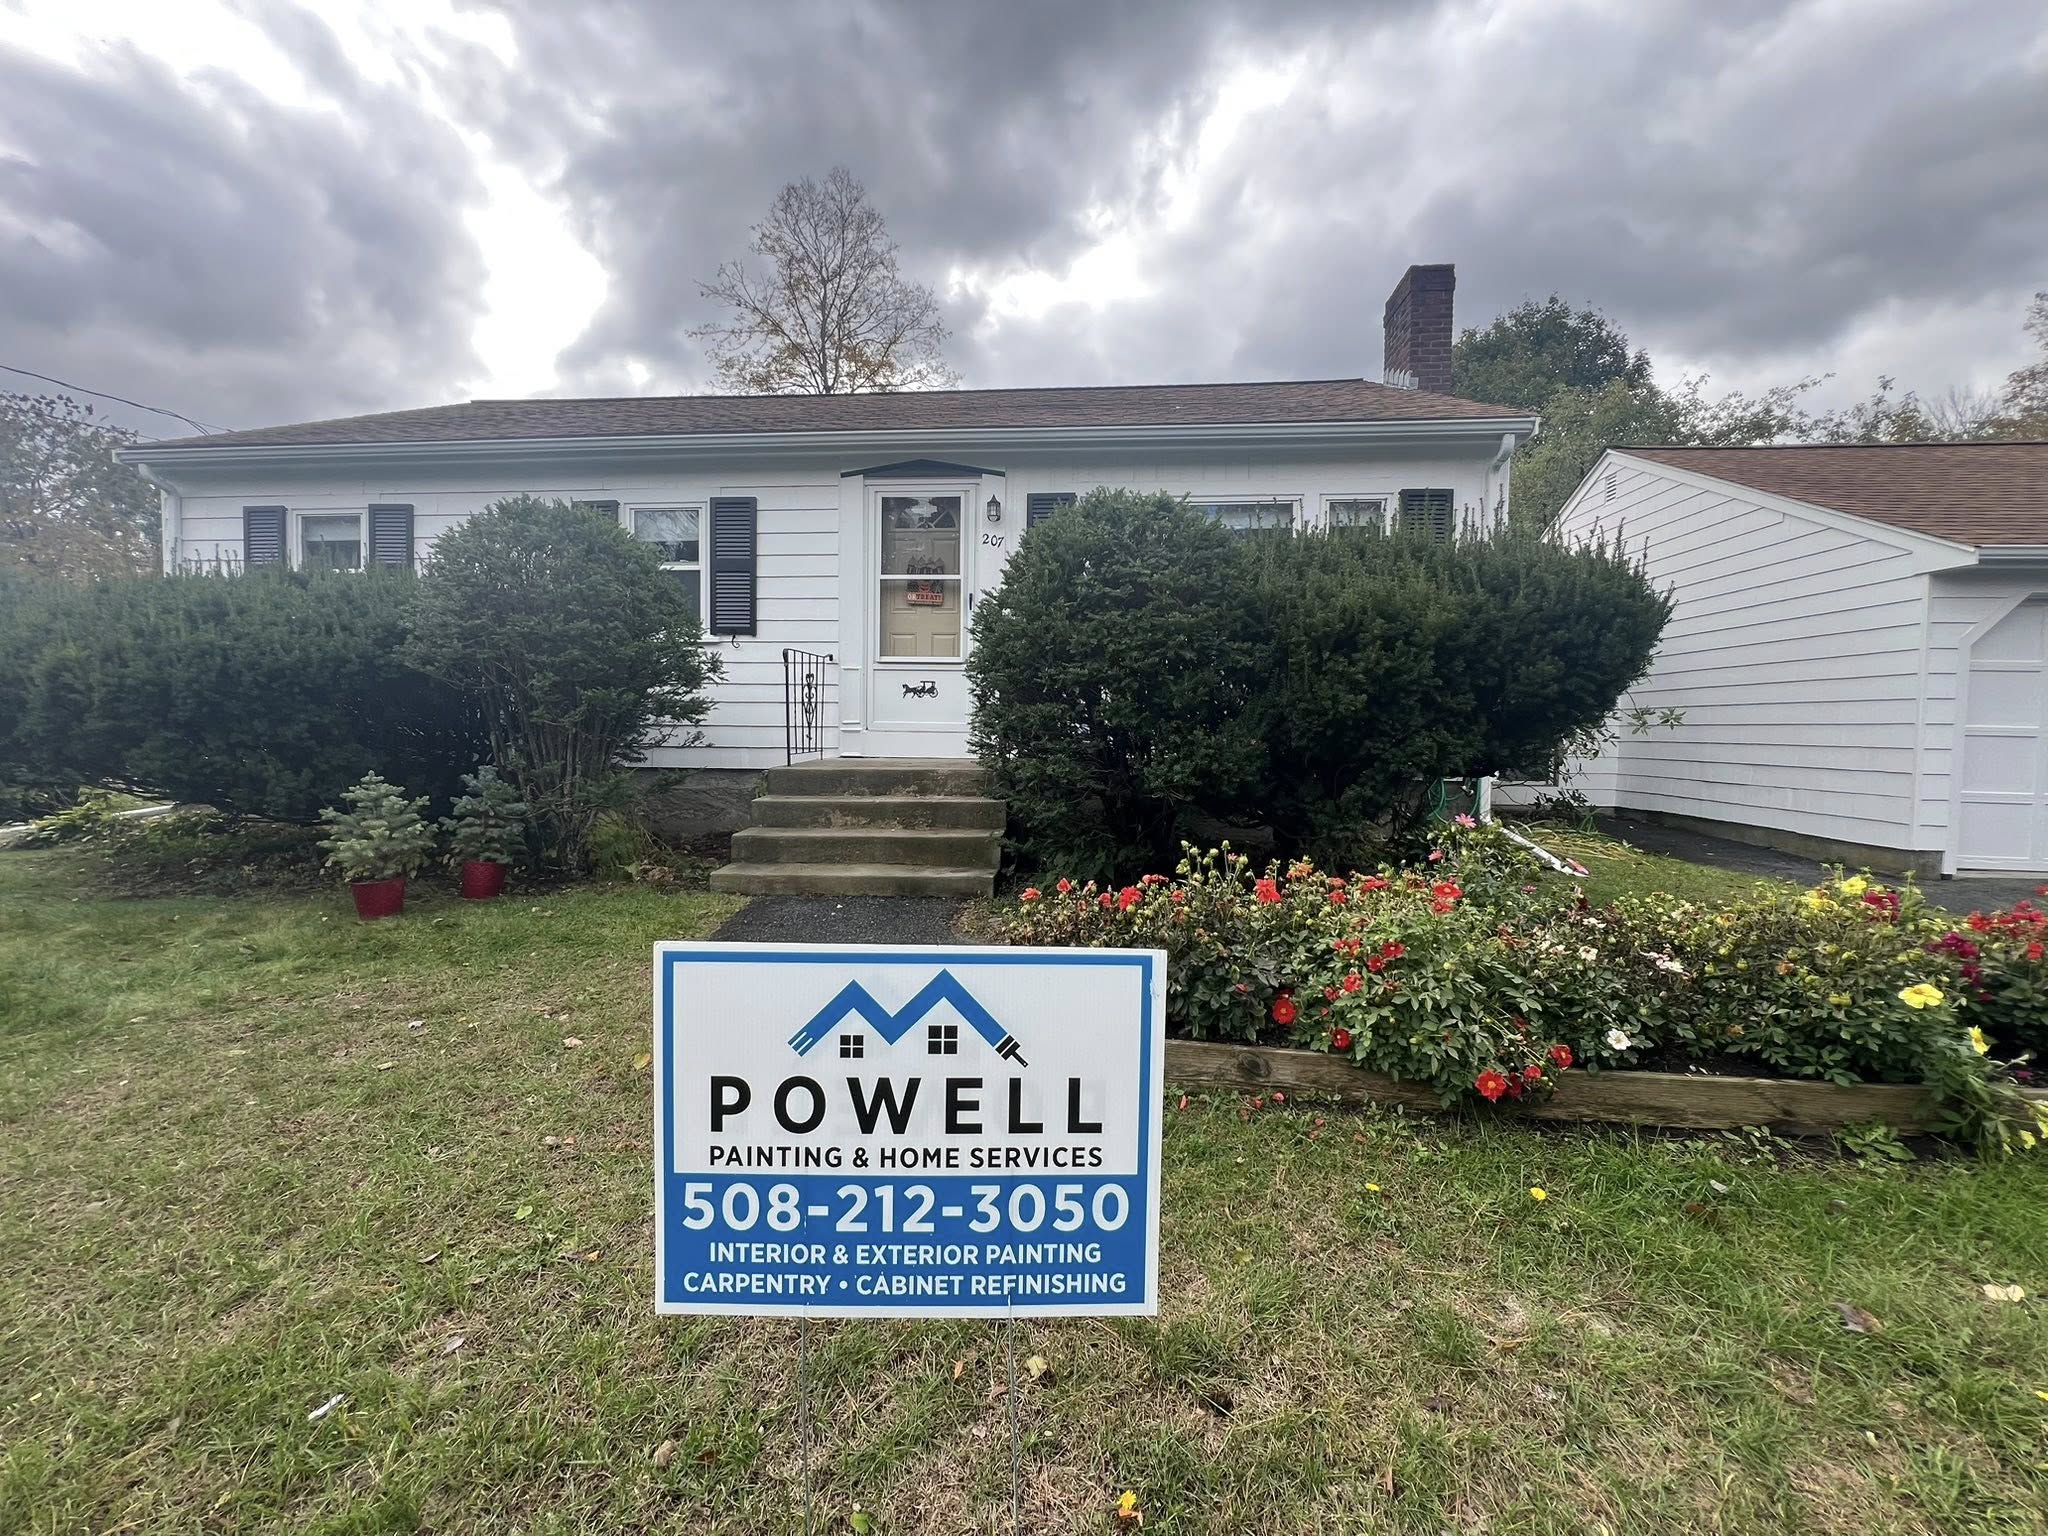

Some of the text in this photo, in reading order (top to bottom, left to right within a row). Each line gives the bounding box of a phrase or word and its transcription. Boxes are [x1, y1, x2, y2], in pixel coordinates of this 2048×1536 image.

[982, 533, 1005, 548] 207
[710, 1075, 1103, 1135] POWELL
[709, 1145, 1103, 1169] PAINTING & HOME SERVICES
[682, 1182, 1129, 1233] 508-212-3050
[710, 1242, 1101, 1265] INTERIOR & EXTERIOR PAINTING
[683, 1271, 1126, 1296] CARPENTRY CABINET REFINISHING
